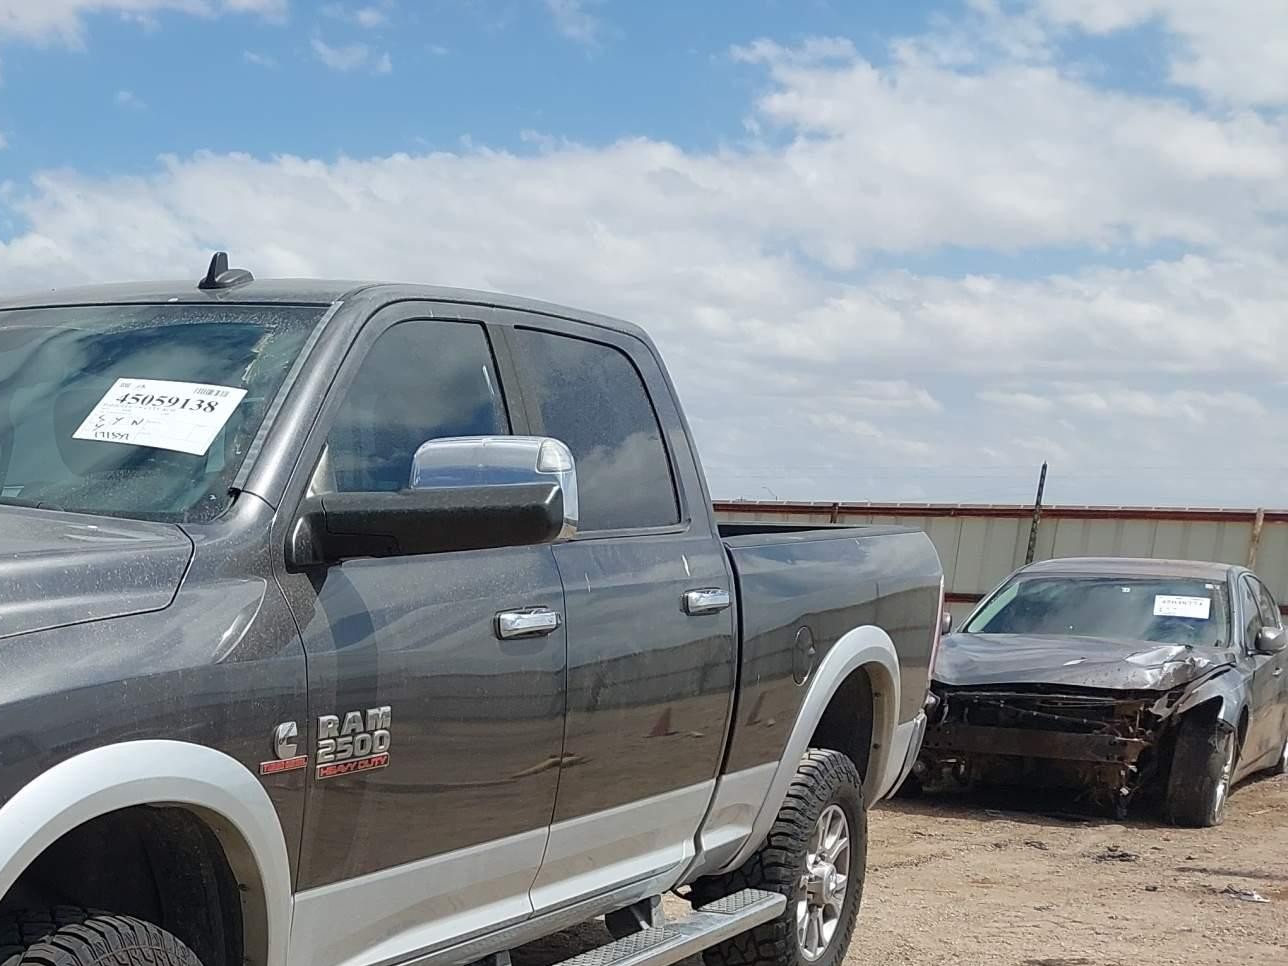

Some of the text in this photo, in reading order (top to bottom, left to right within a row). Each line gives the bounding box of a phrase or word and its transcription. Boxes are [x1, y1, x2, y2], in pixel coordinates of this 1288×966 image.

[116, 392, 219, 413] 45059138
[317, 705, 392, 739] RAM
[316, 729, 391, 763] 2500
[320, 762, 357, 777] HEAVY
[357, 755, 388, 769] DUTY
